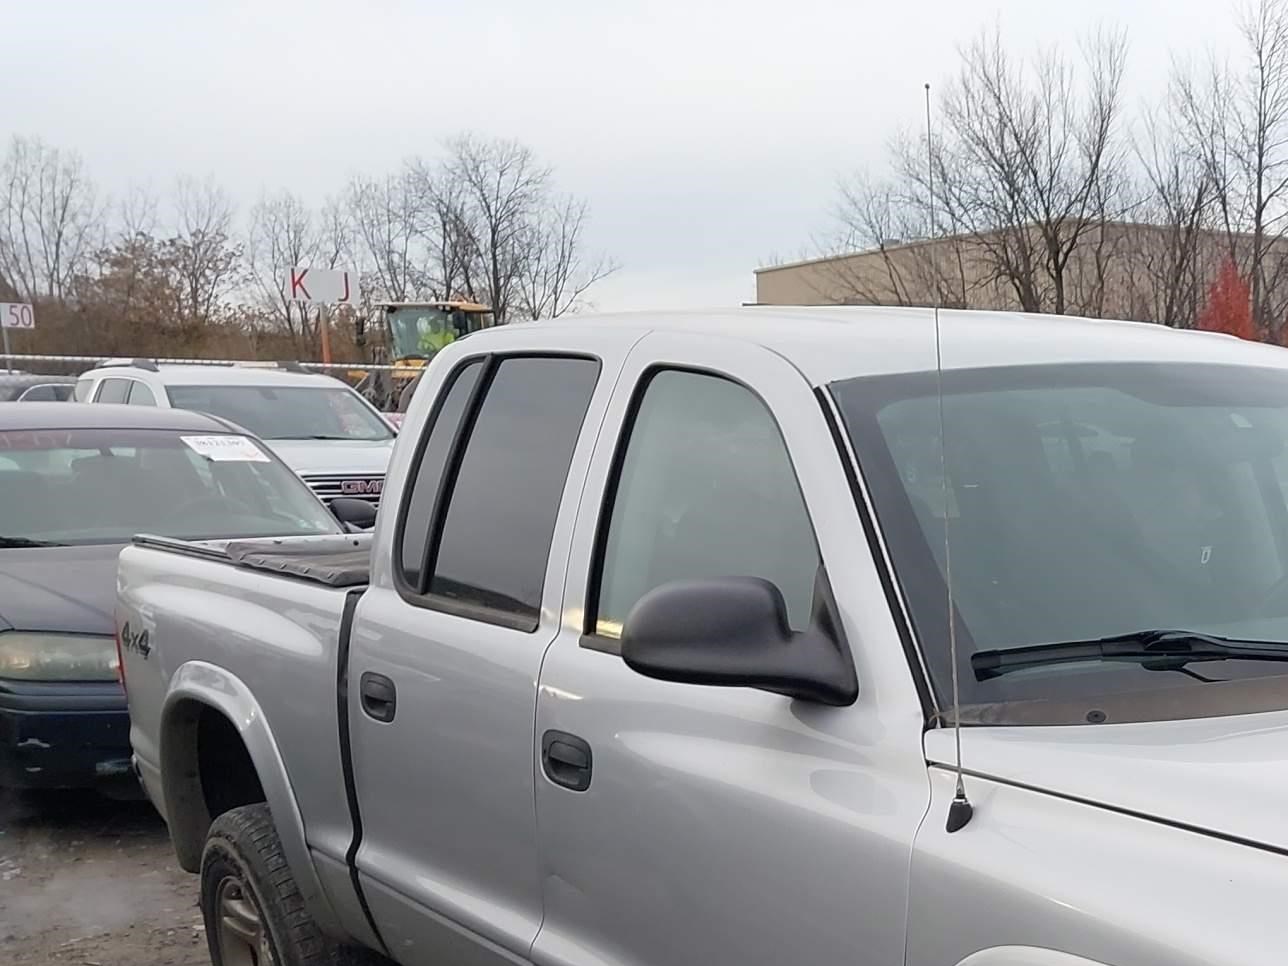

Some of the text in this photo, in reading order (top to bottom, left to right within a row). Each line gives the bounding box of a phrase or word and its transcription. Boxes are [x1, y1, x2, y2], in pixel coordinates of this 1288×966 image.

[290, 267, 350, 302] K J
[9, 304, 32, 327] 50
[341, 480, 383, 493] GM
